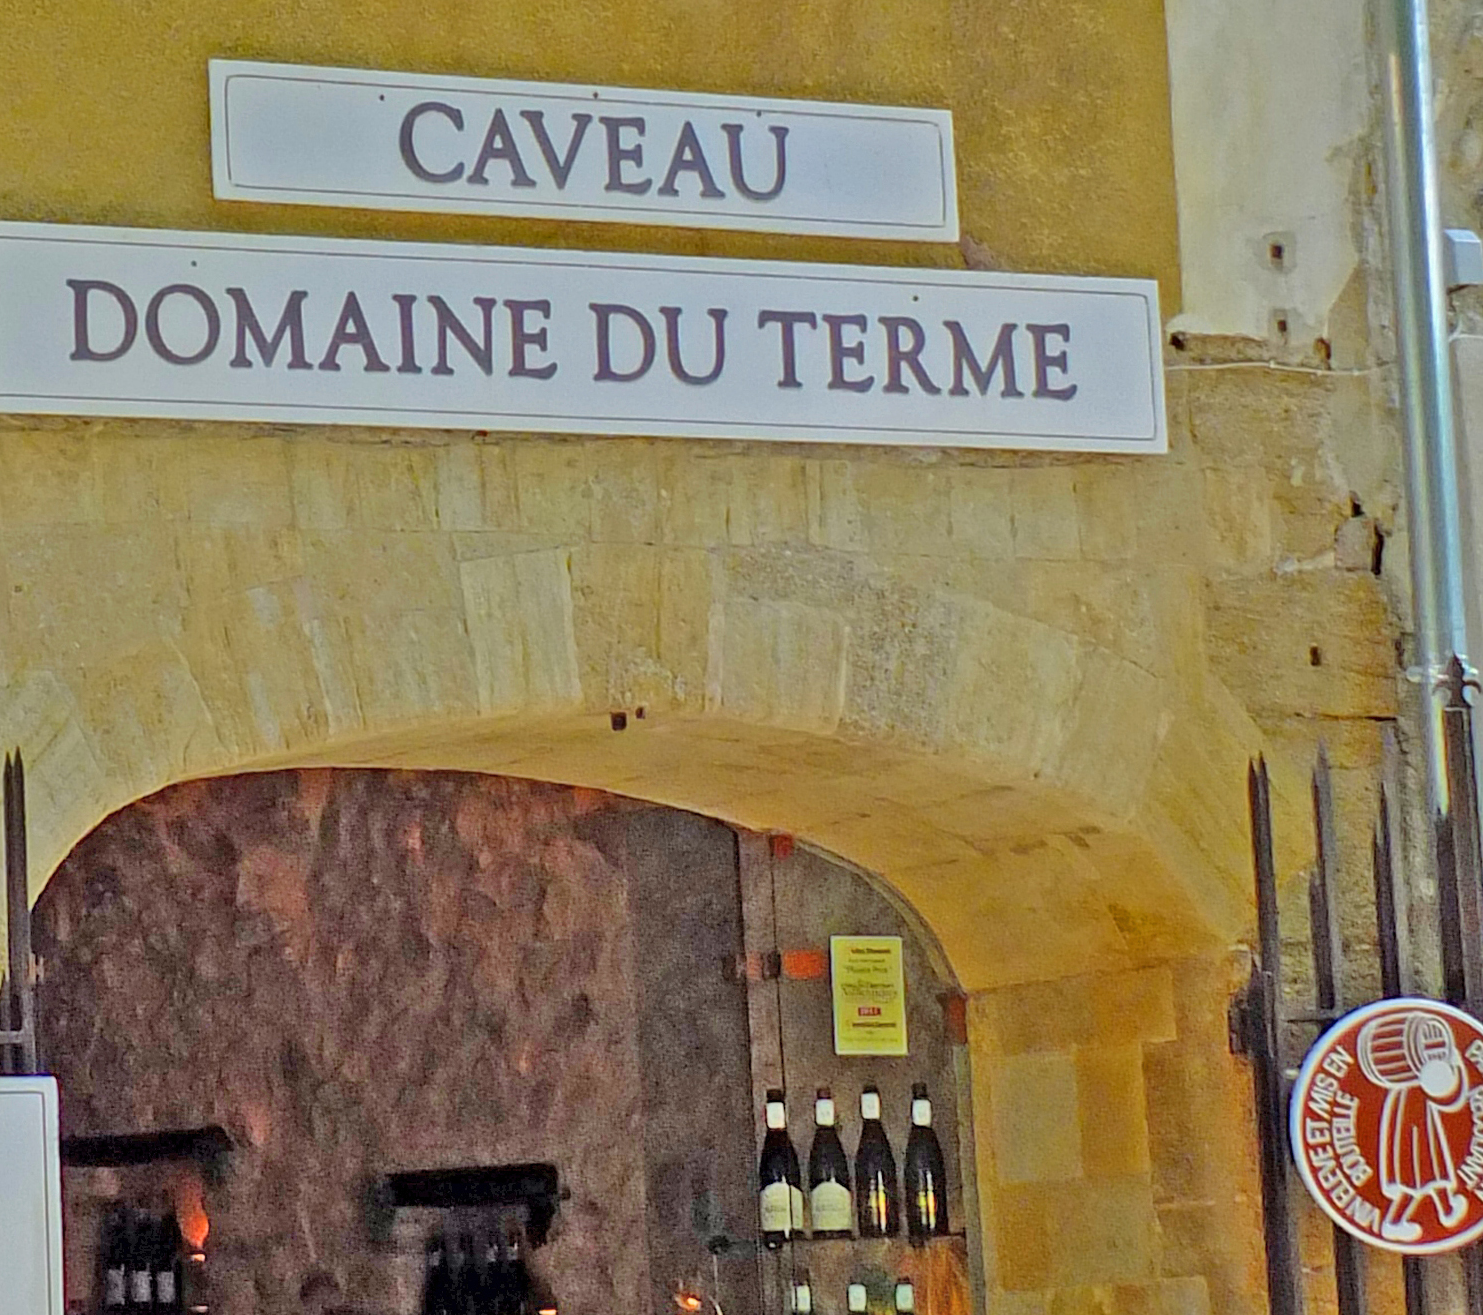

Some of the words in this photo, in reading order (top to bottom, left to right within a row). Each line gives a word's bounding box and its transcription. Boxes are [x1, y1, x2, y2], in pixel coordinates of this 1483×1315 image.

[398, 100, 790, 203] CAVEAU
[65, 277, 558, 381] DOMAINE
[587, 301, 729, 387] DU
[757, 309, 1078, 402] TERME
[1322, 1044, 1356, 1079] EN
[1307, 1072, 1339, 1120] MIS
[1305, 1117, 1331, 1146] ET
[1331, 1090, 1374, 1188] BOUTEILLE
[1309, 1144, 1356, 1209] ELEVE
[1346, 1195, 1381, 1235] VIN
